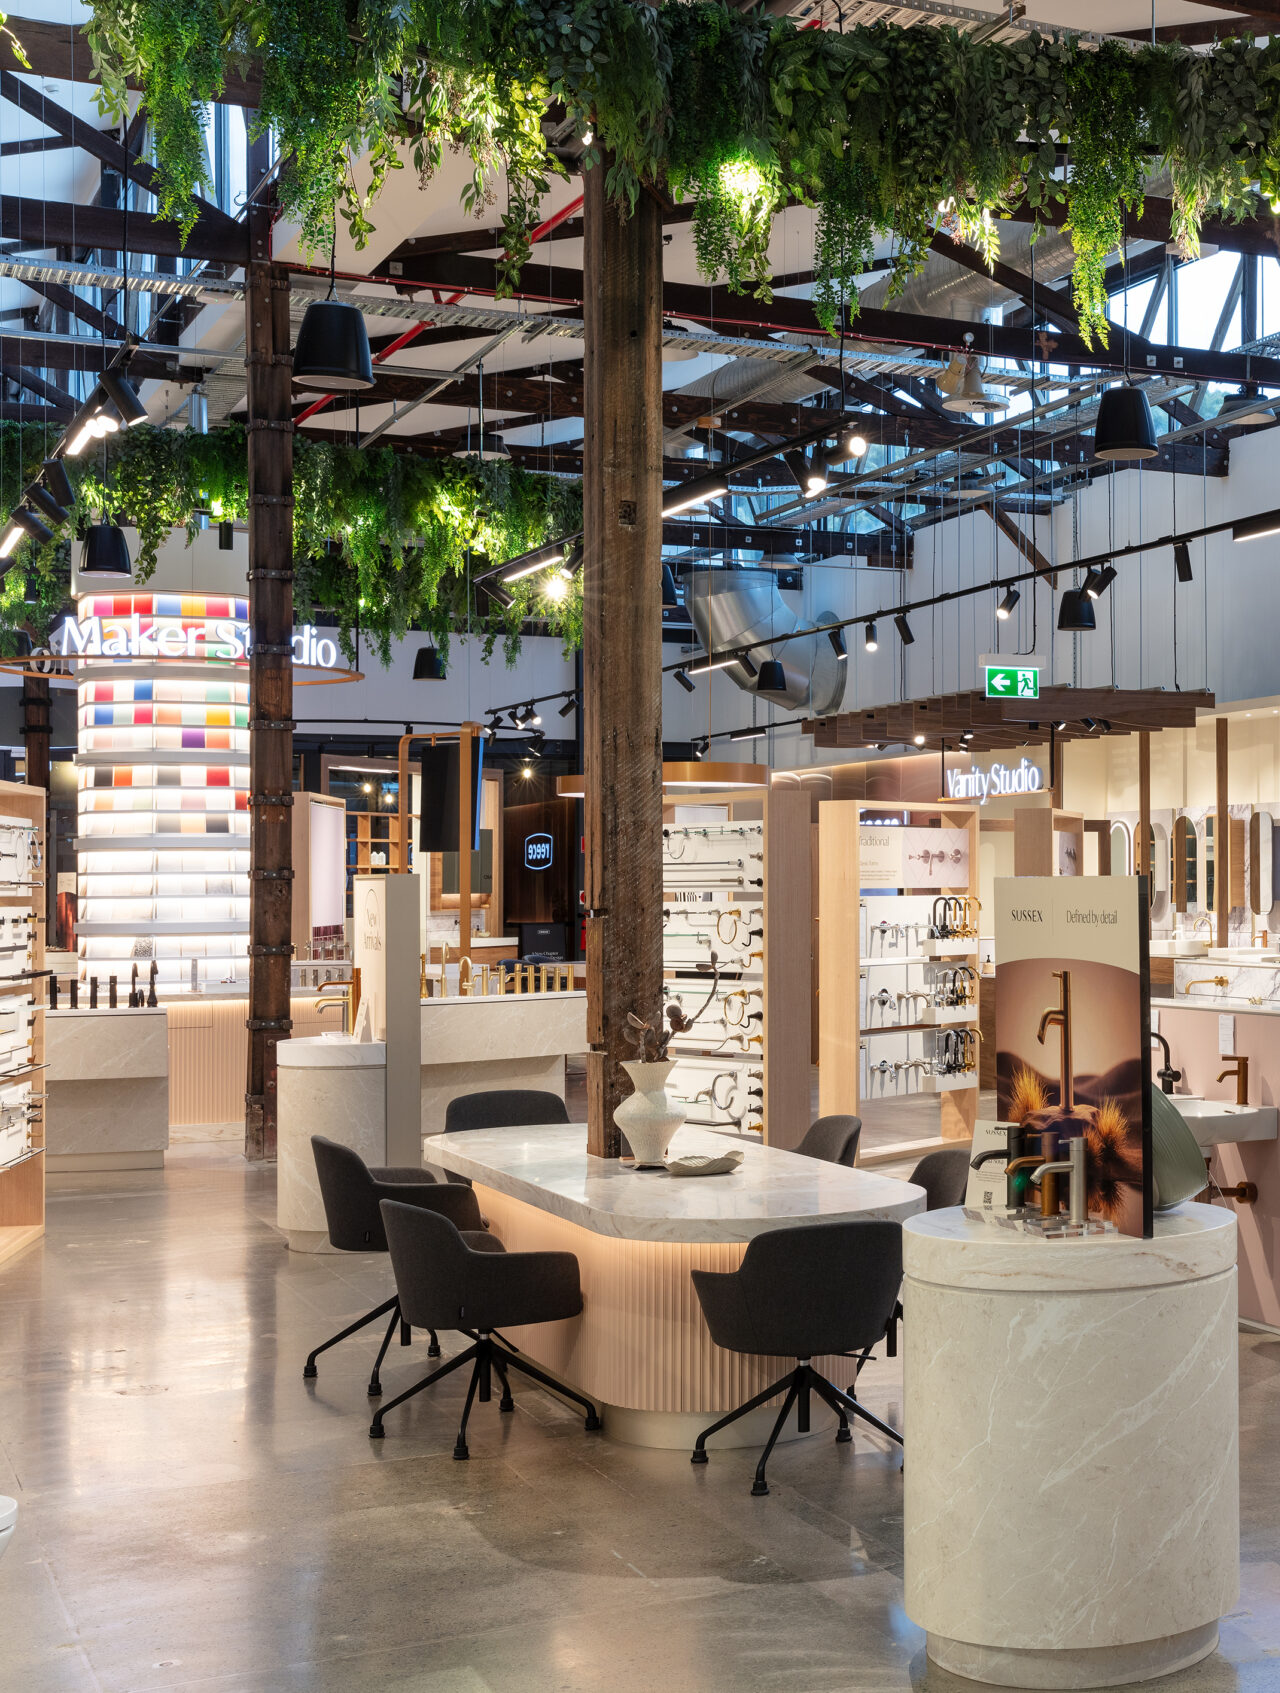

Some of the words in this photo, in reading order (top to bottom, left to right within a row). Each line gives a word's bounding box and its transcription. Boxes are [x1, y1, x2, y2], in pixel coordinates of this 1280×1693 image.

[61, 613, 207, 657] Maker
[215, 621, 338, 668] Stdio
[947, 765, 990, 805] Vanity
[990, 757, 1040, 796] Studio
[1011, 909, 1043, 923] SUSSEX
[1066, 909, 1091, 924] Defined
[1091, 910, 1100, 928] by
[1100, 910, 1118, 924] detail
